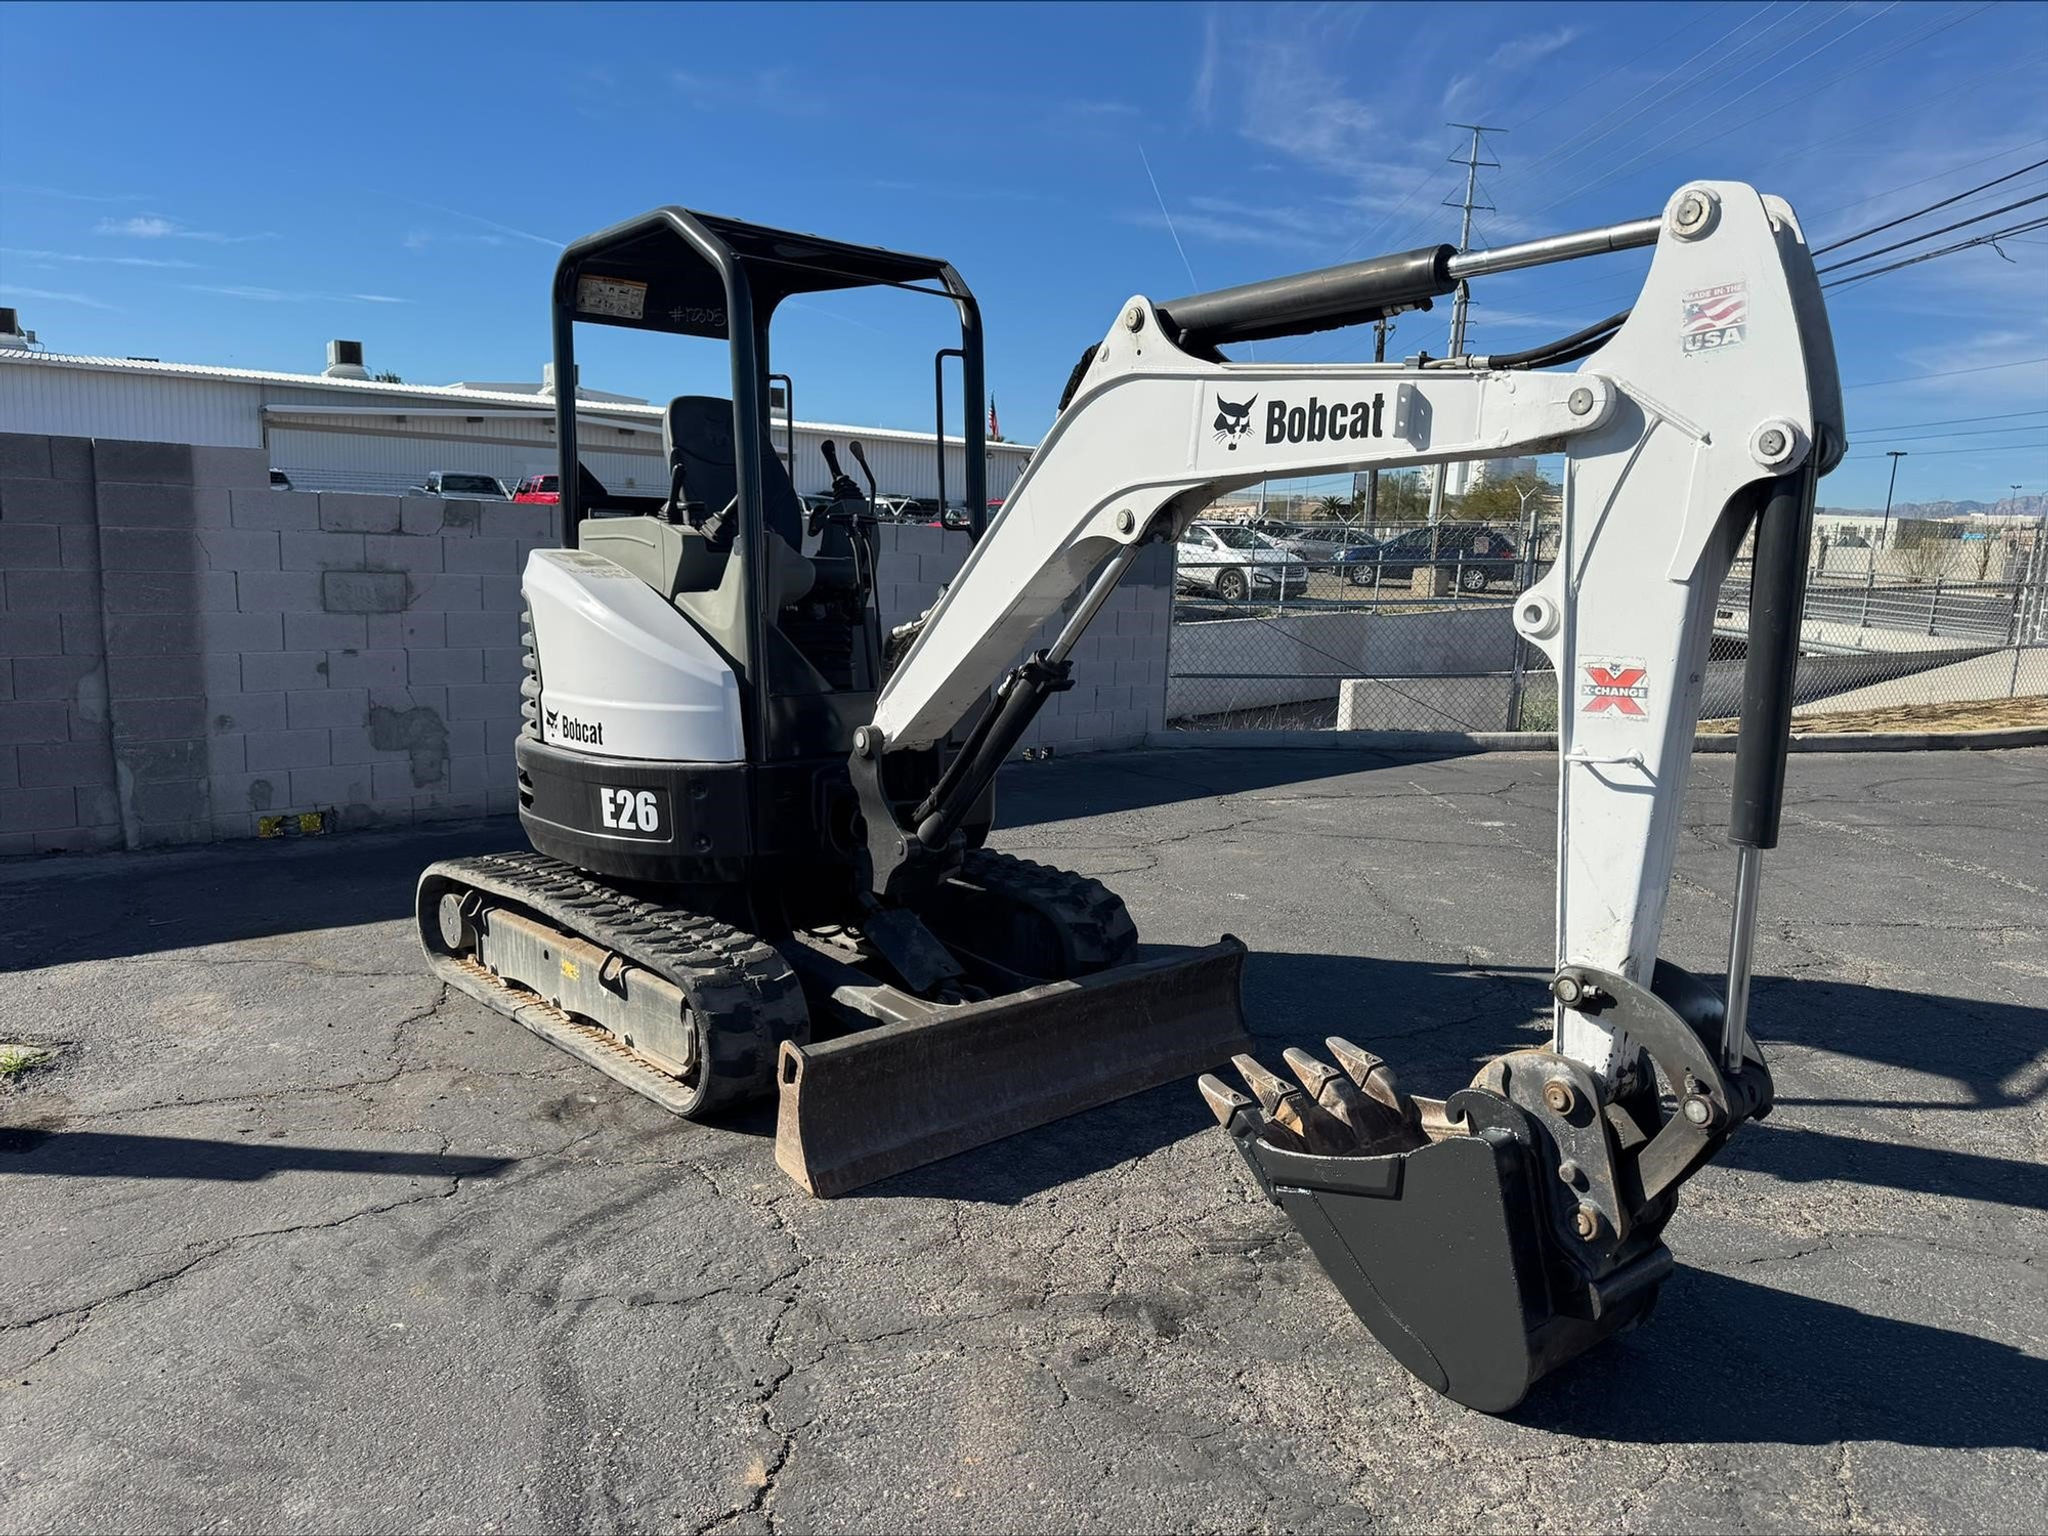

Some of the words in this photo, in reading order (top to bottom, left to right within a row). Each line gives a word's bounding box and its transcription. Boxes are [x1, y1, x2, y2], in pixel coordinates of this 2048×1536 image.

[1713, 287, 1724, 296] IN
[1684, 327, 1742, 351] USA
[1265, 393, 1385, 444] Bobcat
[1583, 686, 1645, 697] X-CHANGE
[562, 715, 604, 746] Bobcat
[600, 788, 659, 833] E26
